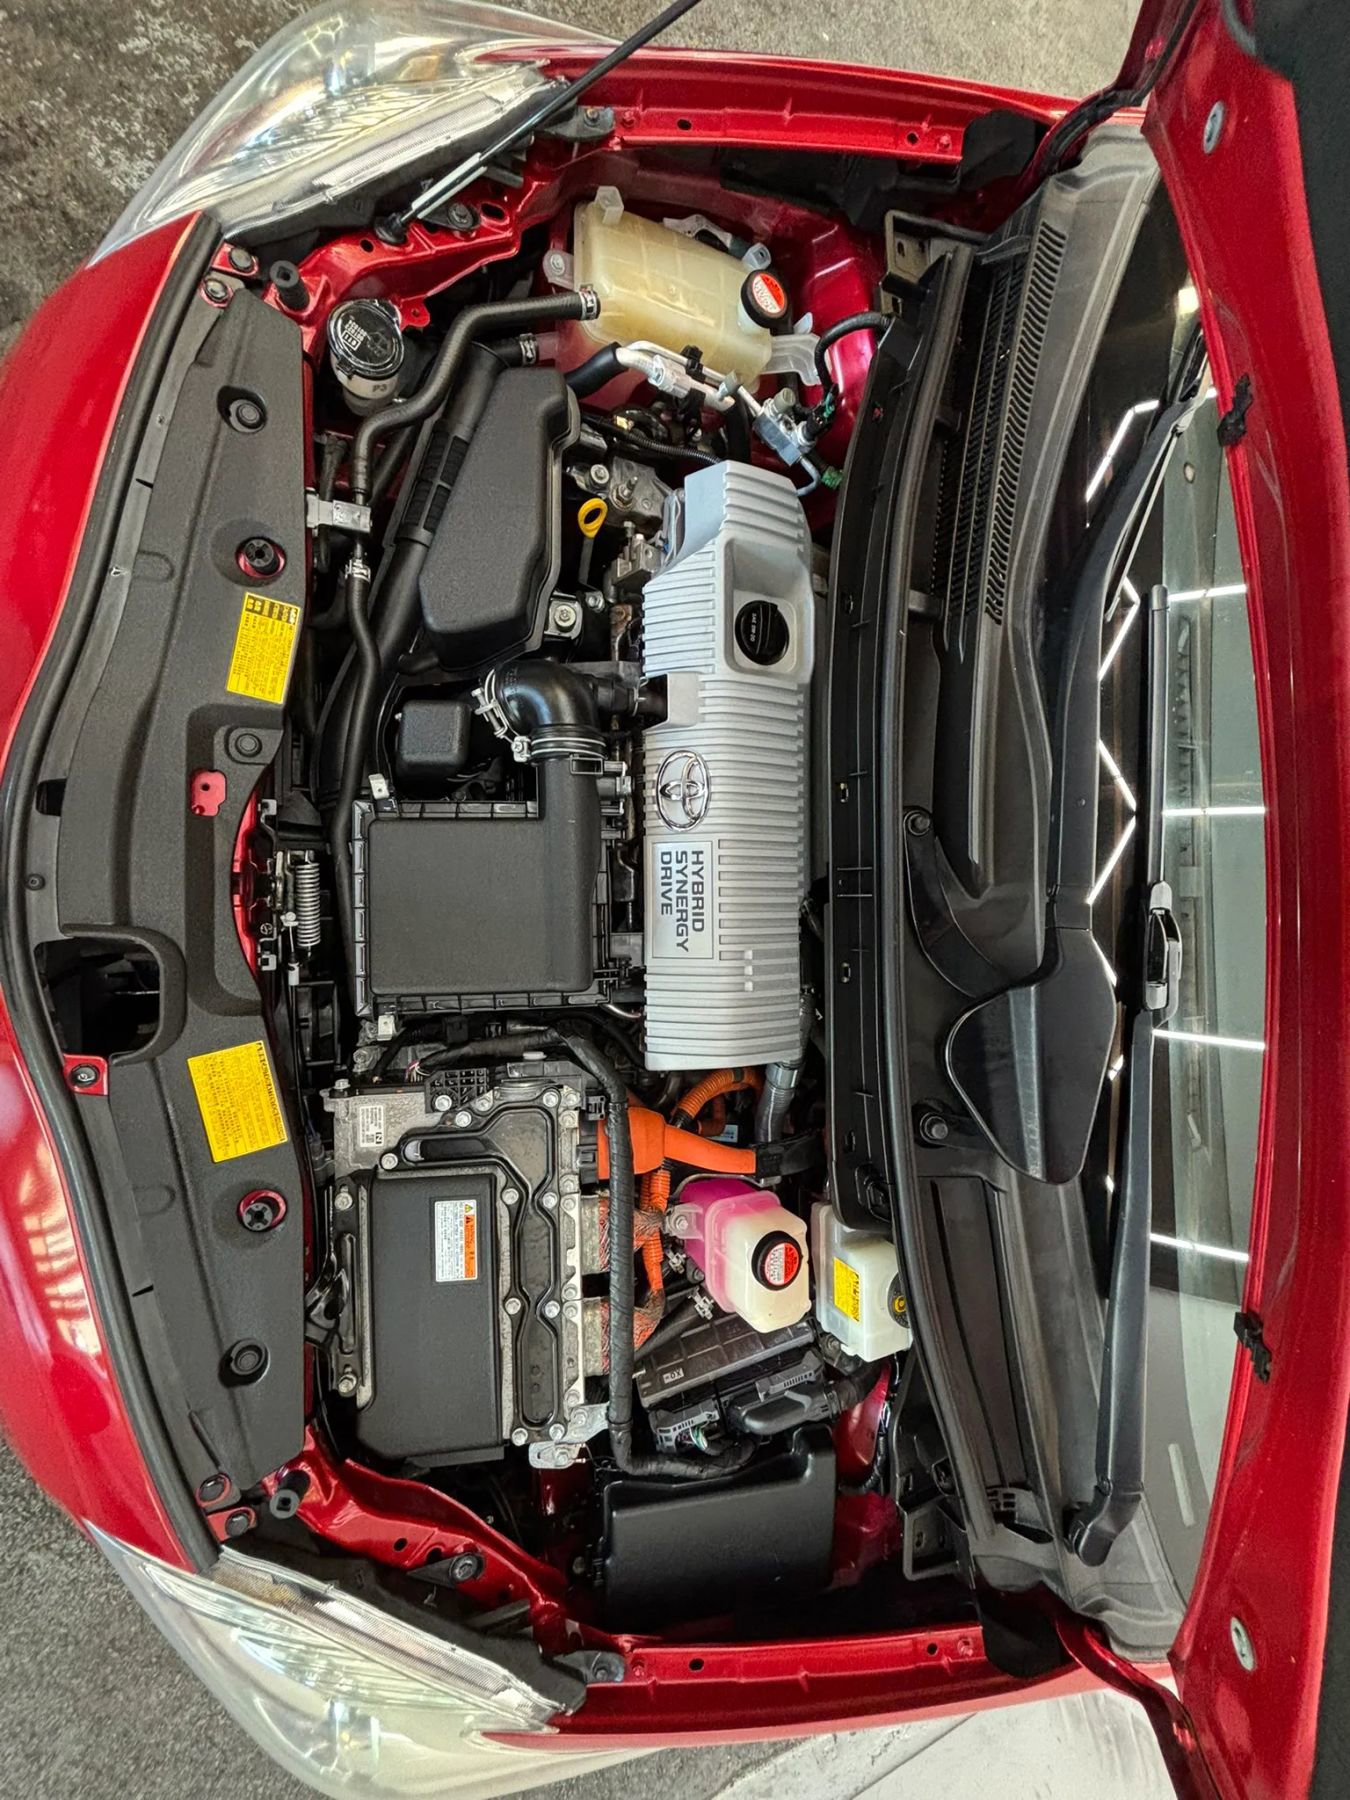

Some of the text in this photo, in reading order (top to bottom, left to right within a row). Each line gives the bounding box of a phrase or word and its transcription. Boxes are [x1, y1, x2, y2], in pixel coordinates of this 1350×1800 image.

[660, 851, 673, 916] DRIVE
[675, 850, 689, 953] SYNERGY
[691, 850, 705, 933] HYBRID
